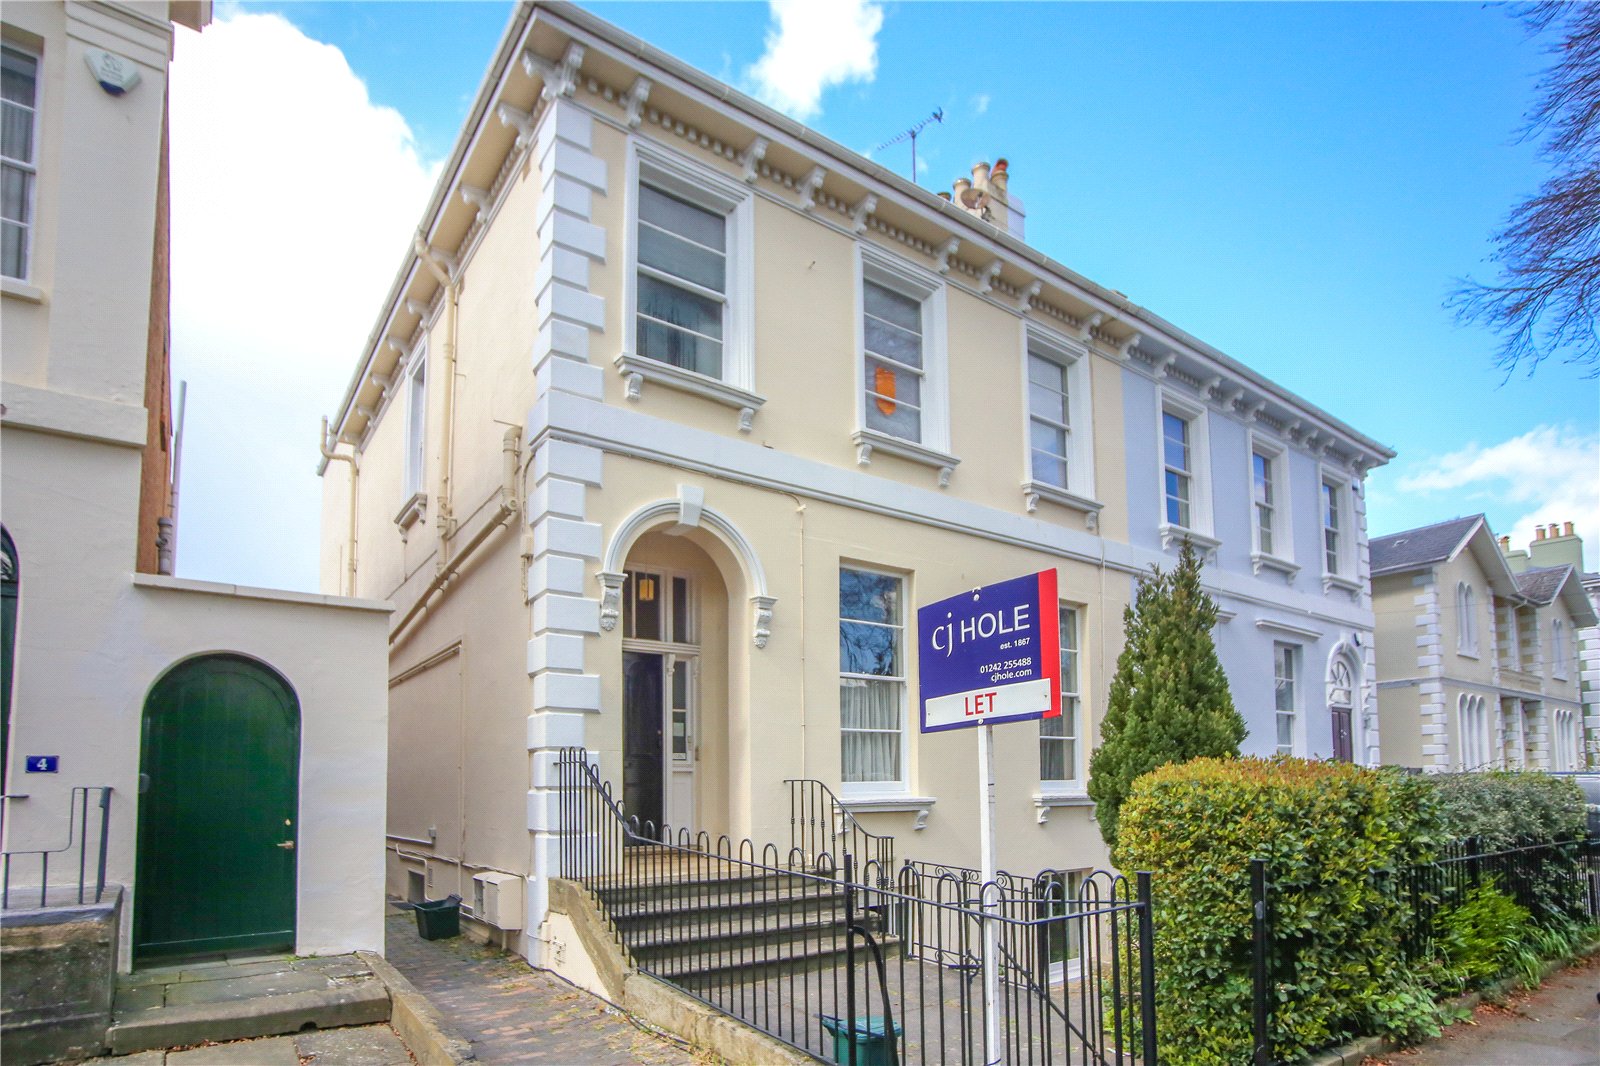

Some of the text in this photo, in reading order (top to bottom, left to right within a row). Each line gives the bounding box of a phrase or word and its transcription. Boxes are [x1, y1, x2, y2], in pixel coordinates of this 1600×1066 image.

[960, 604, 1030, 643] HOLE
[1000, 637, 1030, 650] est. 1867
[980, 656, 1032, 674] 01242 255488
[991, 668, 1032, 683] cjhole.com
[965, 692, 997, 716] LET
[36, 758, 48, 771] 4
